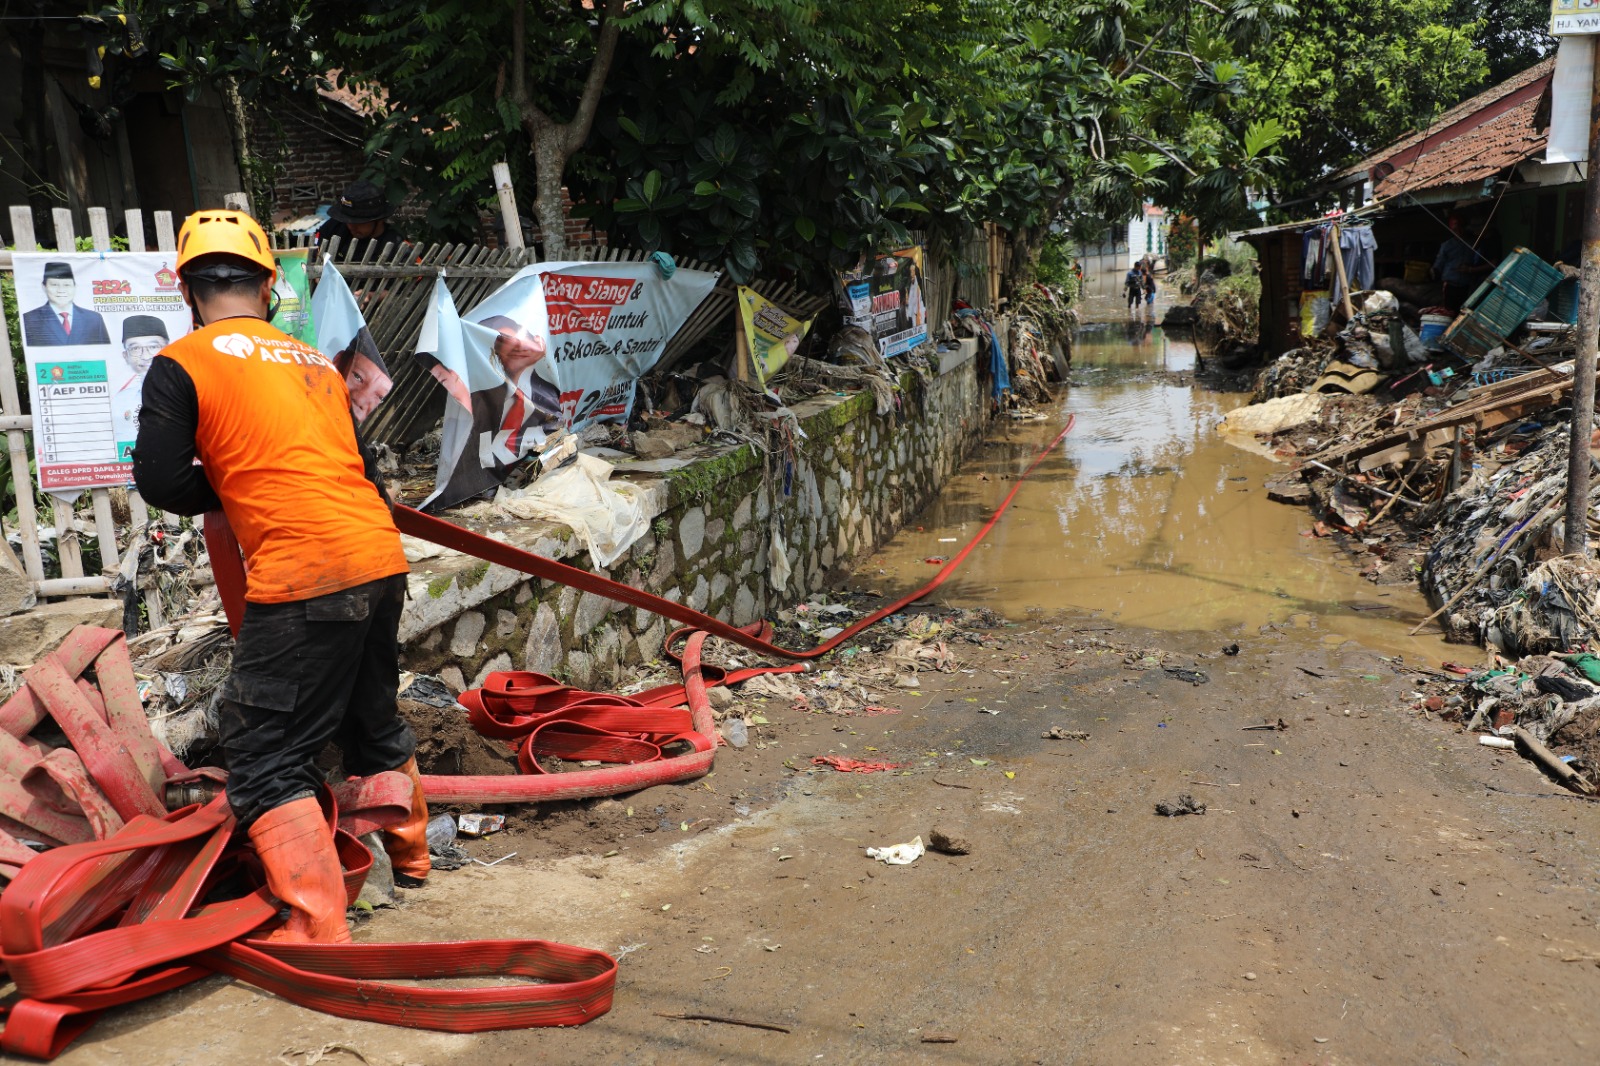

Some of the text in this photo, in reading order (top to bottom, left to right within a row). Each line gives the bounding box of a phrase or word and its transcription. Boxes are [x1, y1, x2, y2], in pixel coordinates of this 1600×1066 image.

[92, 280, 132, 295] 2024
[584, 279, 630, 305] Siang
[630, 282, 643, 300] &
[93, 295, 183, 304] PRABOWO PRESIDEN
[94, 304, 184, 312] INDONESIA MENANG
[567, 309, 607, 331] Gratis
[607, 310, 649, 330] untuk
[252, 335, 295, 350] Rumah
[621, 336, 663, 355] Santri
[40, 368, 47, 379] 2
[39, 386, 47, 398] 1
[53, 386, 107, 396] AEP DEDI
